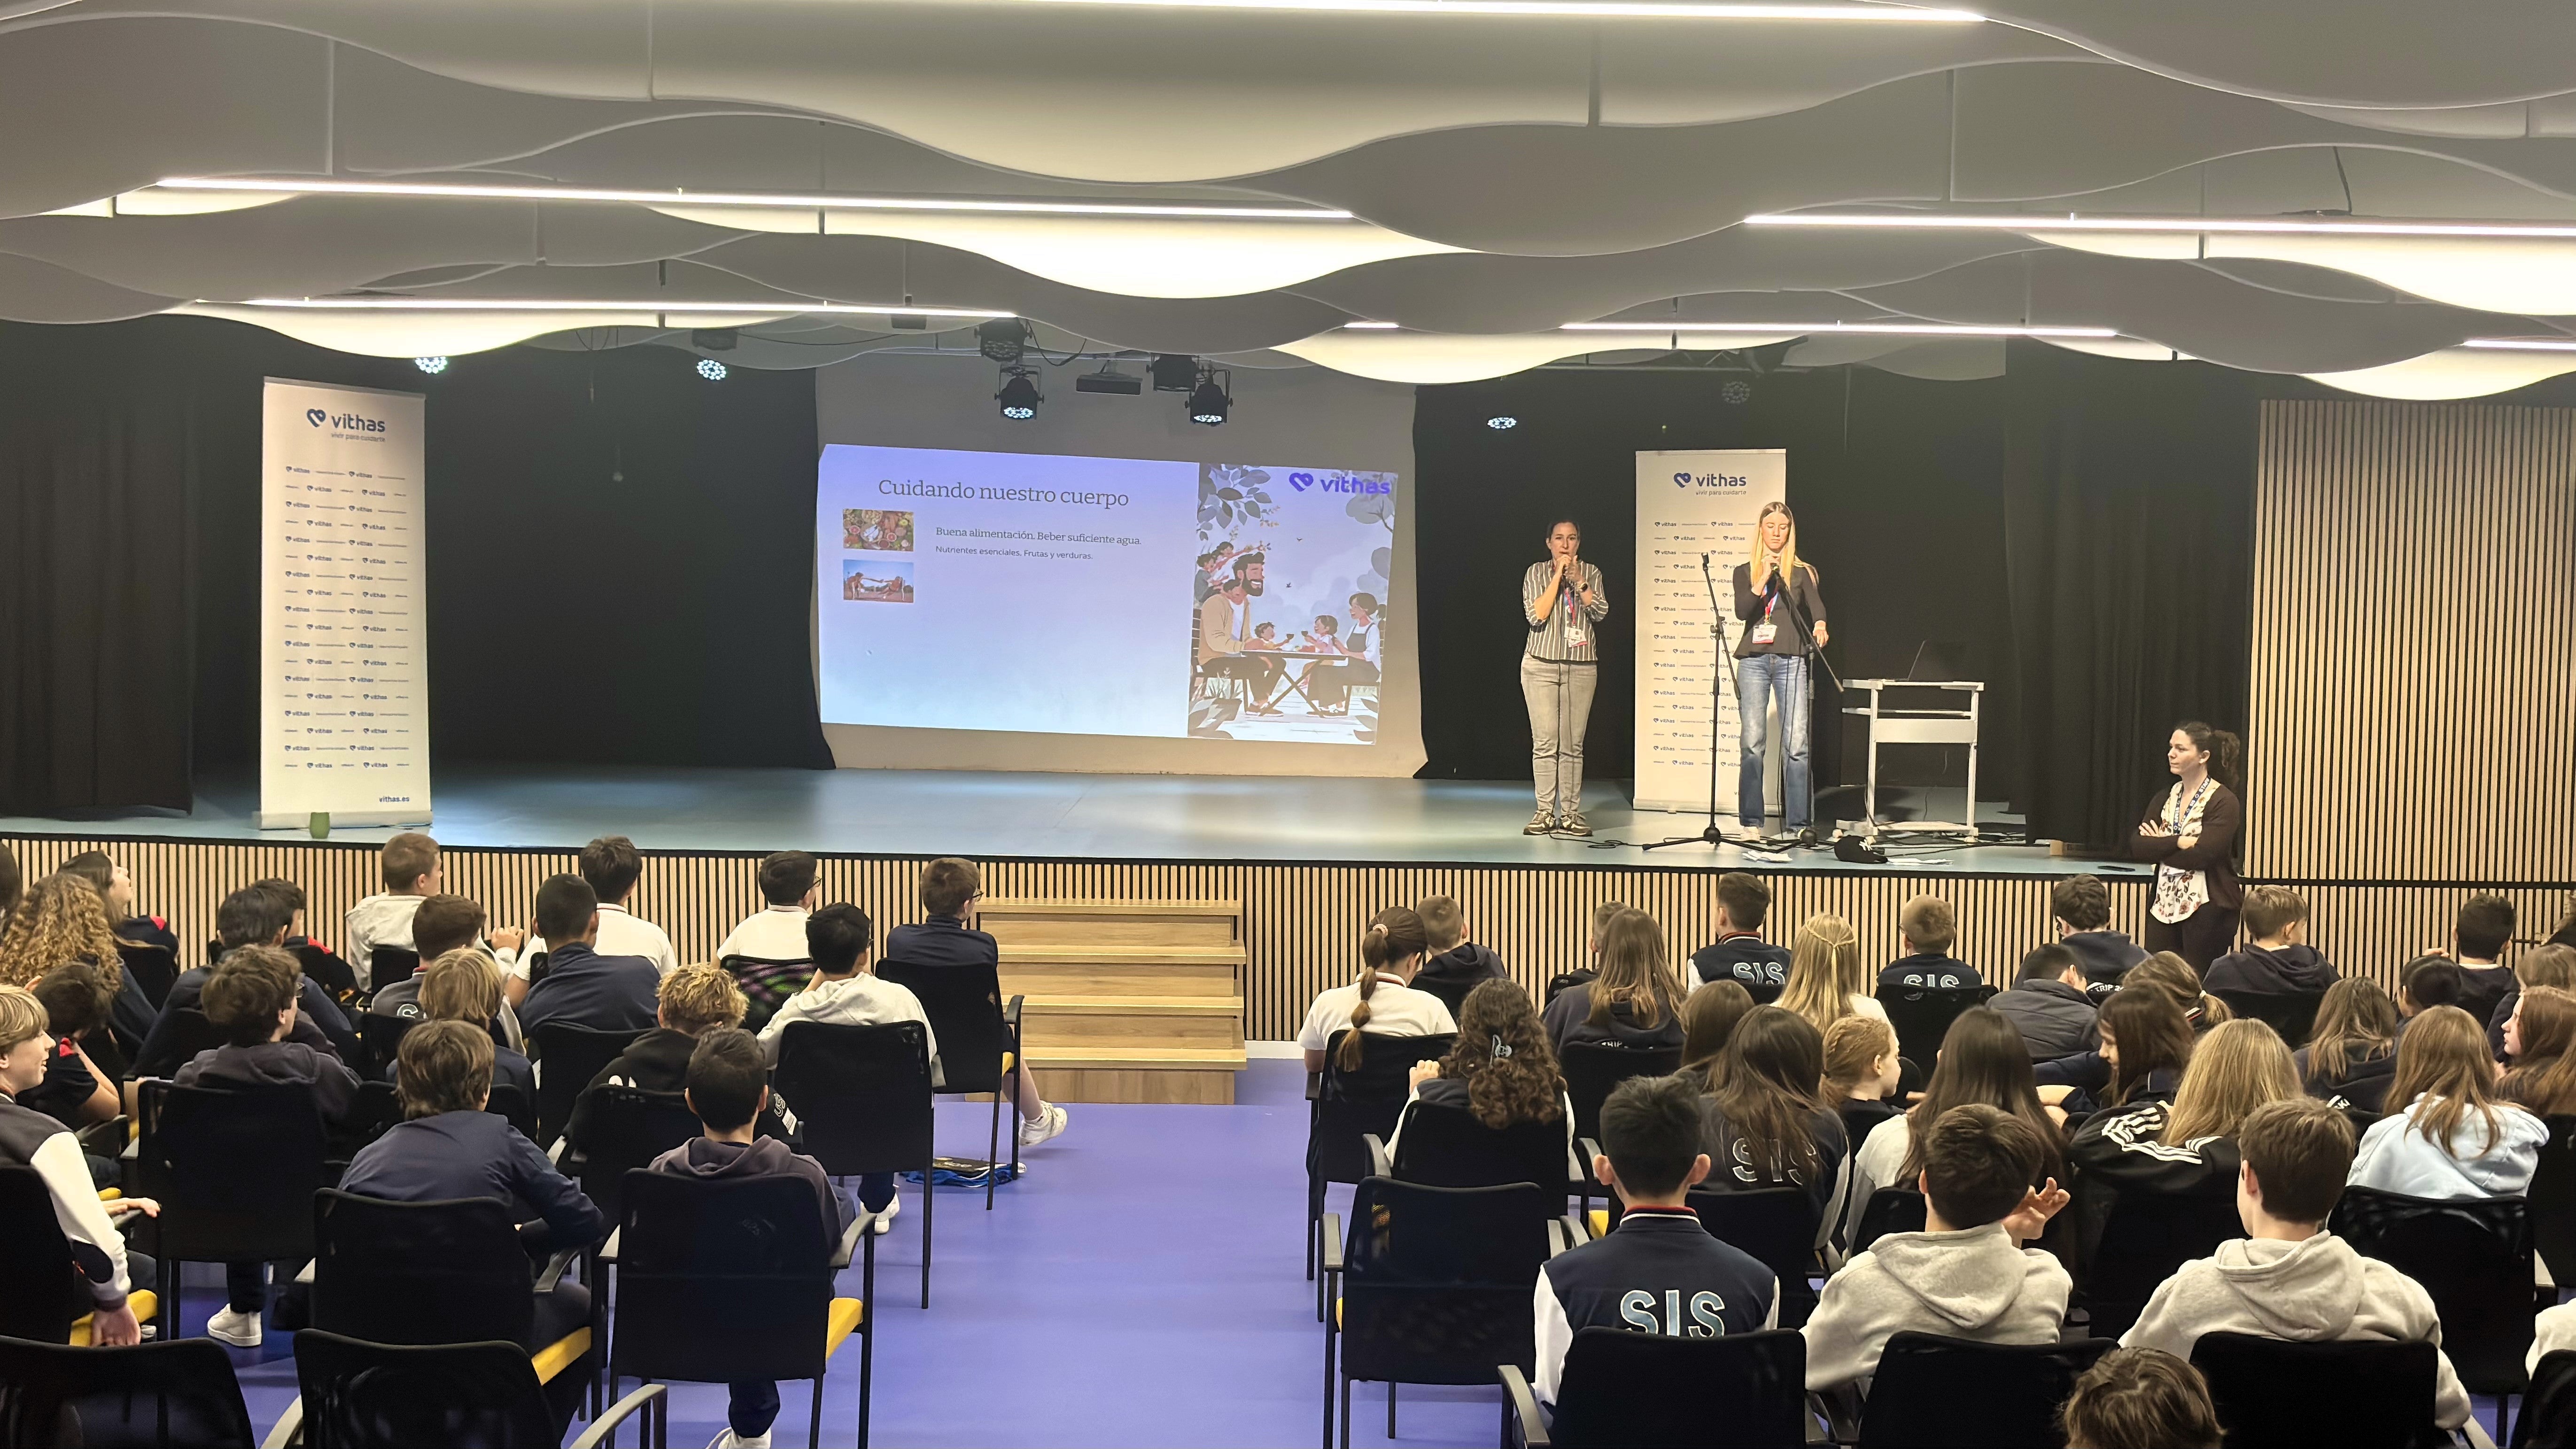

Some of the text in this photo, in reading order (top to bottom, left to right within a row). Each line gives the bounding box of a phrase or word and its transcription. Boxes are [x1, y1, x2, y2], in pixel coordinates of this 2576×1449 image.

[331, 413, 385, 432] vithas
[1320, 476, 1390, 494] vithas
[1696, 473, 1746, 487] vithas
[879, 480, 1129, 509] Cuidando nuestro cuerpo
[936, 527, 1141, 546] Buena alimentación. Beber suficiente agua.
[1733, 962, 1785, 984] SIS
[1620, 1289, 1725, 1338] SIS
